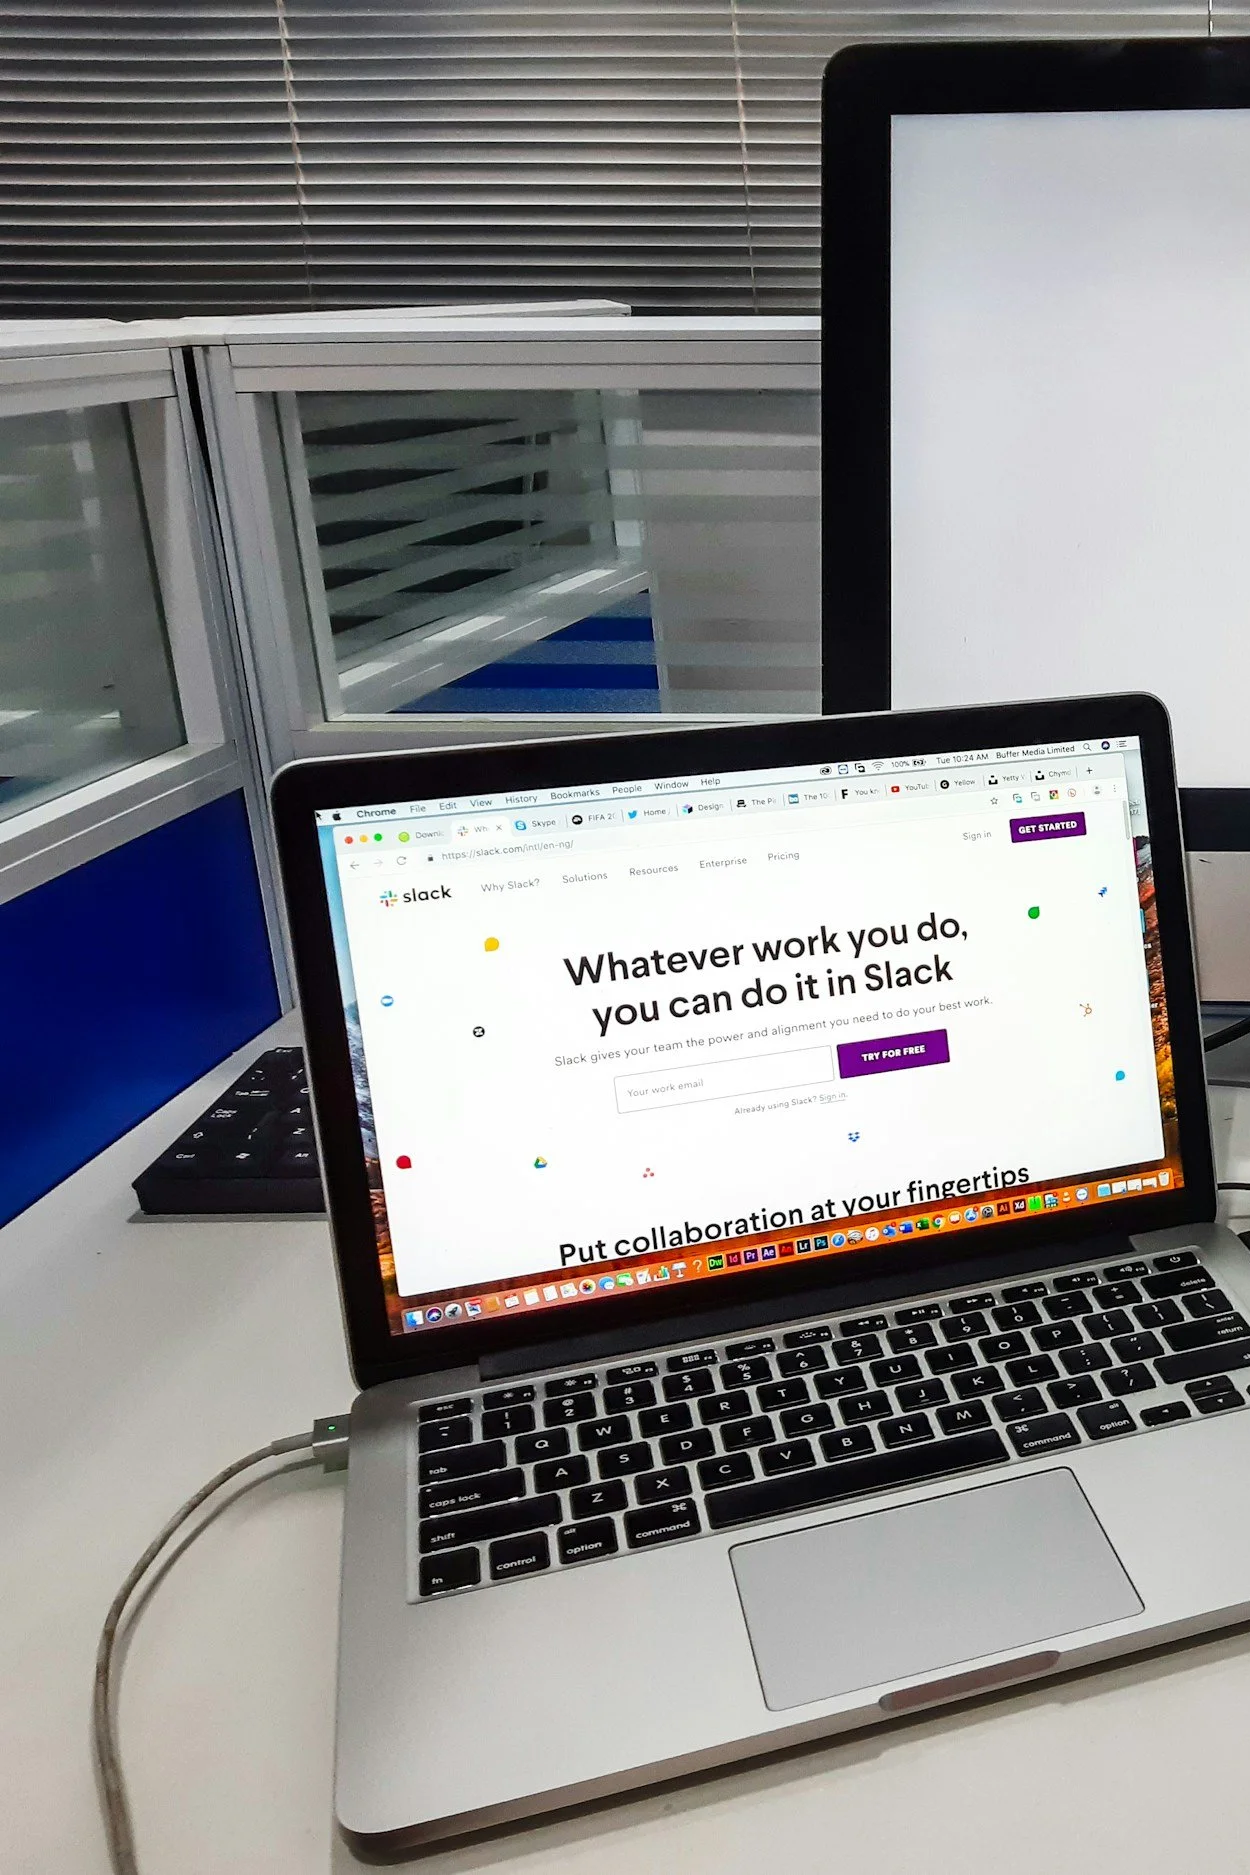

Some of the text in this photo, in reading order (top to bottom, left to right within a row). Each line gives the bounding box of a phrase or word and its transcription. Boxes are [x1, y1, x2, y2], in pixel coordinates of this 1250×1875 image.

[996, 745, 1075, 759] Buffer Media Limited
[891, 760, 909, 768] 100%
[654, 780, 689, 790] Window
[700, 777, 720, 786] Help
[954, 778, 975, 787] Yellow
[550, 788, 600, 800] Bookmarks
[612, 785, 642, 795] People
[470, 798, 492, 808] View
[505, 794, 538, 804] History
[410, 805, 426, 813] File
[439, 802, 457, 811] Edit
[357, 807, 396, 818] Chrome
[643, 808, 666, 816] Home
[588, 813, 605, 822] FIFA
[532, 819, 556, 828] Skype
[1018, 821, 1077, 834] GET STARTED
[963, 832, 981, 841] Sign
[768, 851, 800, 862] Pricing
[700, 857, 747, 868] Enterprise
[629, 864, 678, 877] Resources
[562, 871, 608, 884] Solutions
[481, 878, 540, 894] Why Slack?
[403, 885, 452, 904] slack
[563, 912, 969, 986] Whatever work you do,
[592, 955, 953, 1037] you can do it in Slack
[554, 996, 994, 1067] Slack gives your team the power and alignment you need to do your best work.
[862, 1044, 926, 1062] TRY FOR FREE
[627, 1078, 704, 1098] Your work email
[734, 1105, 765, 1116] Already
[768, 1100, 789, 1112] using
[791, 1096, 817, 1106] Slack?
[820, 1093, 836, 1102] Sign
[999, 1204, 1008, 1212] Ai
[1014, 1201, 1025, 1210] Xd
[559, 1166, 1030, 1267] Put collaboration at your fingertips
[816, 1239, 826, 1247] Ps
[746, 1252, 755, 1260] Pr
[763, 1249, 774, 1257] Ae
[709, 1259, 722, 1267] Dw
[729, 1255, 738, 1263] Id
[1180, 1277, 1205, 1288] delete
[1014, 1314, 1023, 1322] 0
[1052, 1330, 1061, 1338] P
[1217, 1326, 1243, 1335] return
[800, 1360, 808, 1368] 6
[890, 1365, 901, 1374] U
[1028, 1365, 1037, 1373] L
[743, 1372, 751, 1380] 5
[834, 1377, 844, 1386] Y
[973, 1377, 984, 1385] K
[684, 1384, 693, 1392] 4
[777, 1389, 786, 1398] T
[919, 1389, 926, 1398] J
[625, 1397, 634, 1405] 3
[720, 1401, 730, 1410] R
[859, 1402, 871, 1410] H
[566, 1409, 574, 1417] 2
[956, 1411, 972, 1420] M
[661, 1414, 669, 1423] E
[801, 1414, 813, 1423] G
[504, 1421, 511, 1429] 1
[1099, 1418, 1129, 1431] option
[596, 1426, 612, 1436] W
[744, 1428, 751, 1436] F
[900, 1425, 912, 1434] N
[535, 1439, 549, 1449] Q
[681, 1440, 692, 1449] D
[842, 1438, 852, 1446] B
[1023, 1433, 1071, 1448] command
[619, 1454, 629, 1463] S
[780, 1451, 791, 1460] V
[429, 1466, 447, 1475] tab
[555, 1468, 568, 1477] A
[719, 1465, 731, 1474] C
[657, 1479, 669, 1488] X
[429, 1492, 481, 1509] caps lock
[592, 1493, 603, 1502] Z
[636, 1520, 690, 1539] command
[431, 1532, 455, 1543] shift
[567, 1541, 602, 1555] option
[497, 1555, 536, 1571] control
